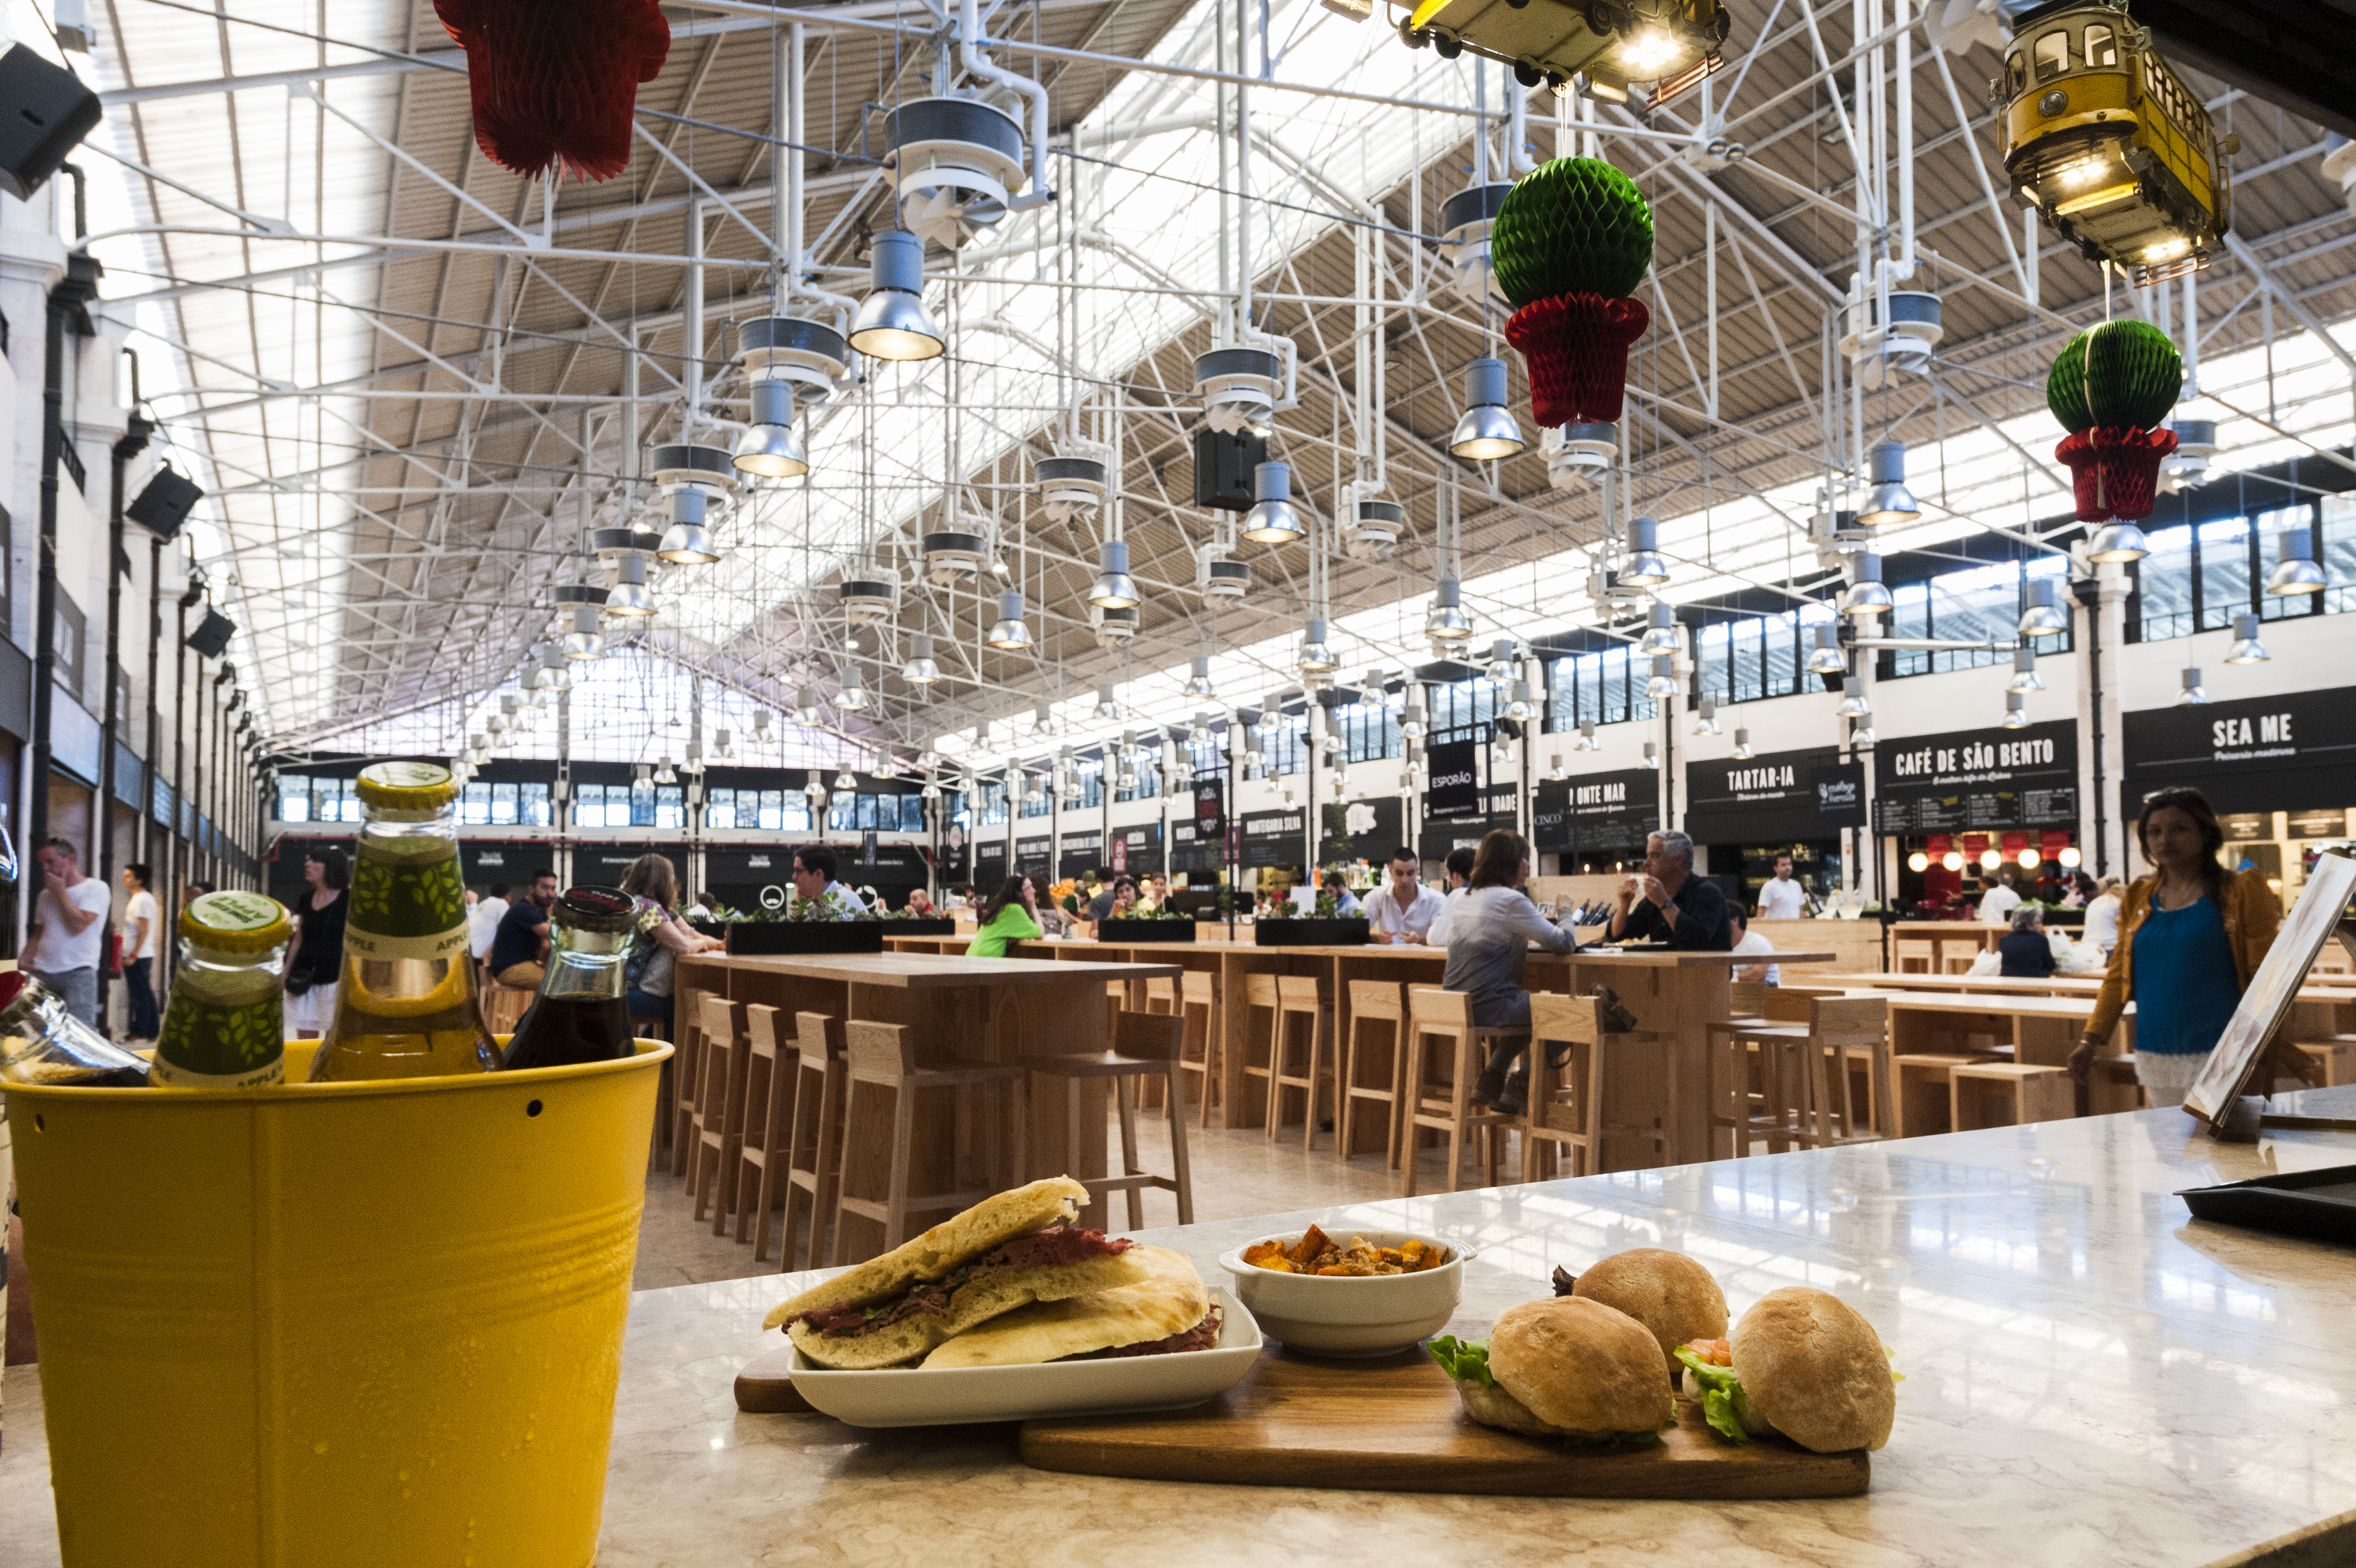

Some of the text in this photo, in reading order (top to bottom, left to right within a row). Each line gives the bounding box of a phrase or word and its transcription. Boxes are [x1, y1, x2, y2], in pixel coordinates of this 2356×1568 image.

[2213, 713, 2292, 747] SEA ME
[1895, 739, 2053, 776] CAFÉ DE SÃO BENTO
[1432, 771, 1471, 788] ESPORÃO
[1604, 782, 1626, 802] MAR
